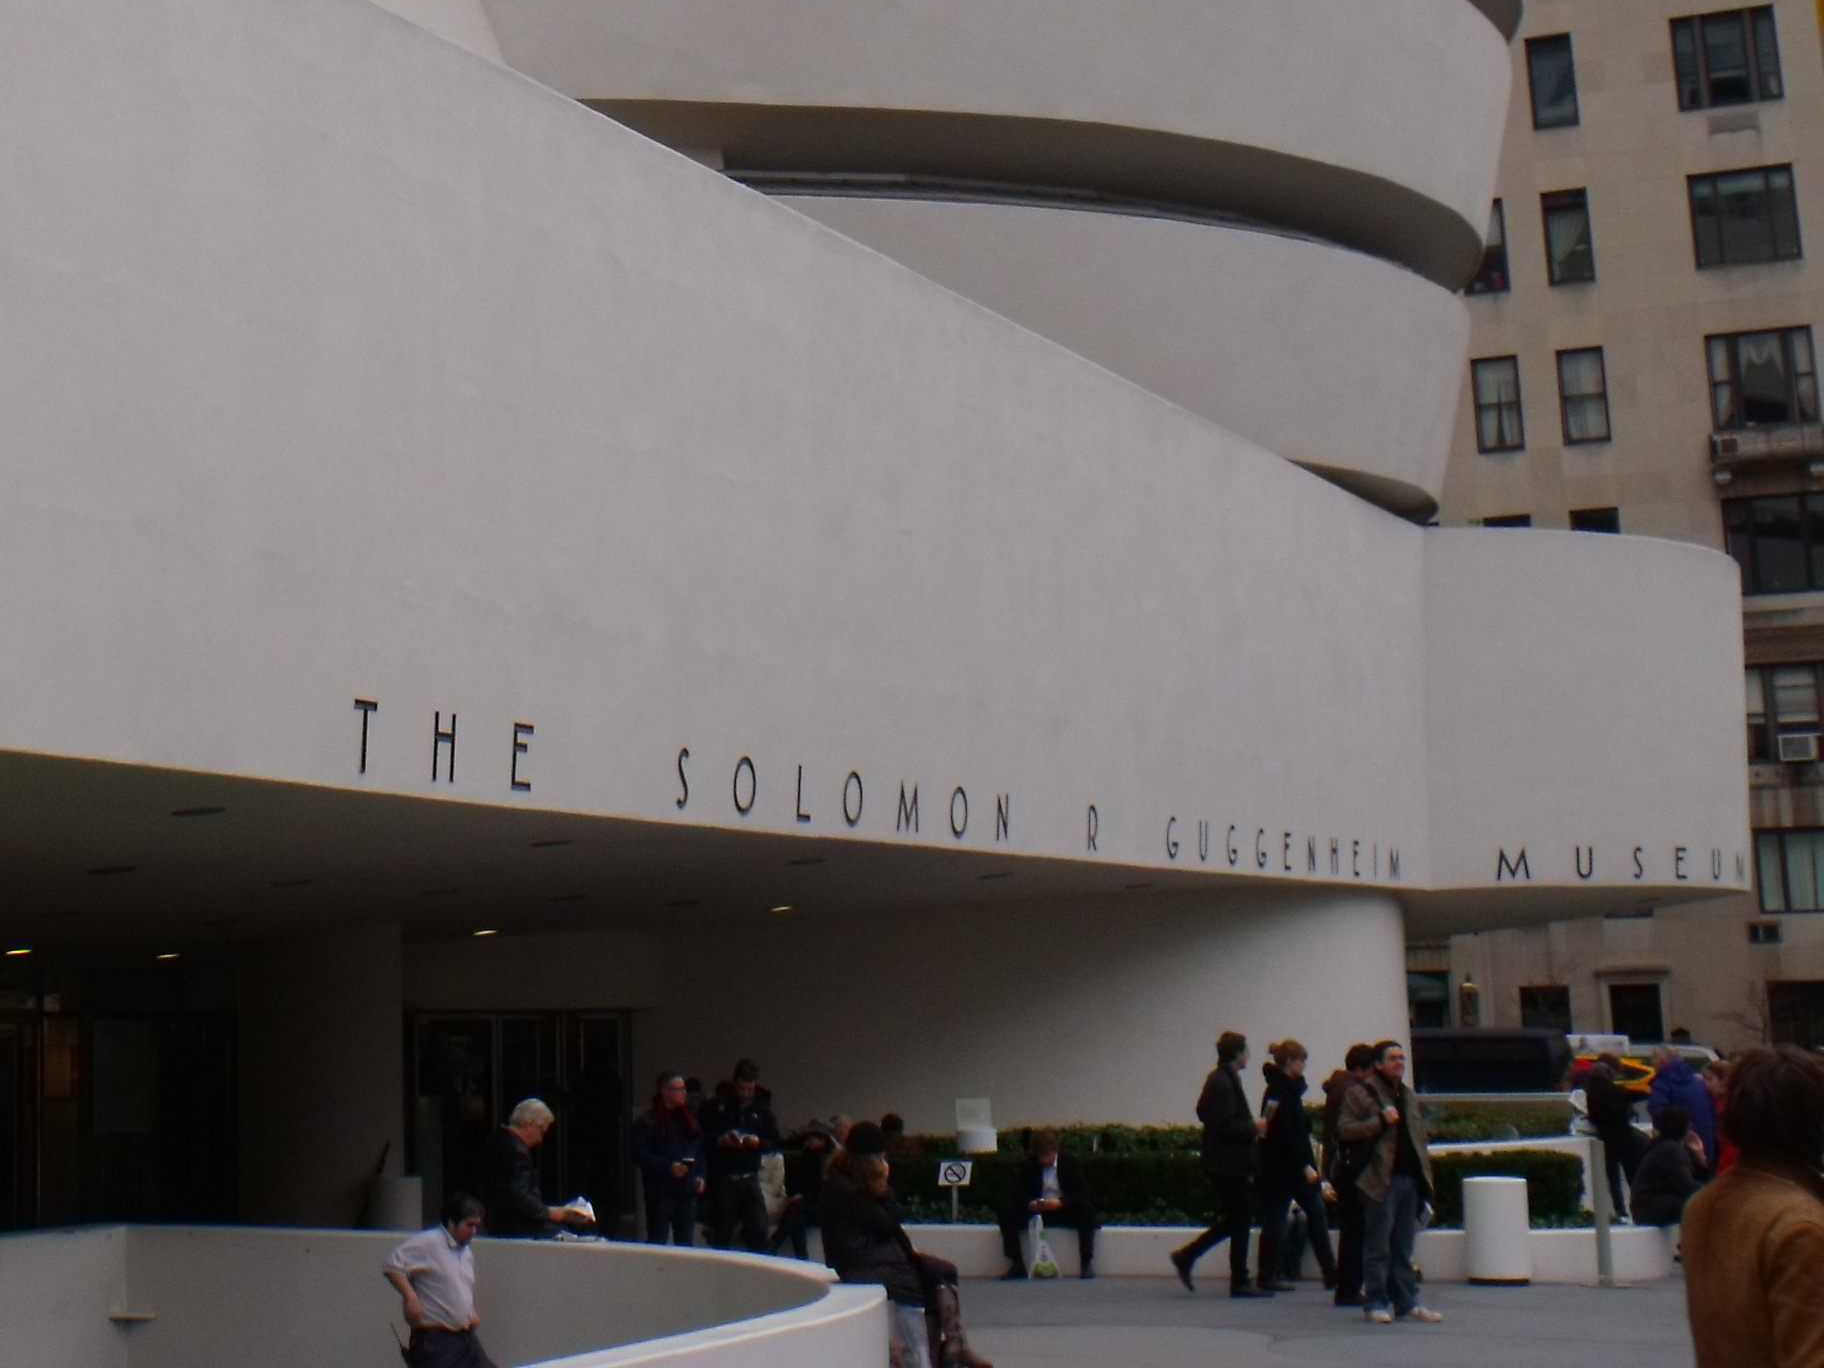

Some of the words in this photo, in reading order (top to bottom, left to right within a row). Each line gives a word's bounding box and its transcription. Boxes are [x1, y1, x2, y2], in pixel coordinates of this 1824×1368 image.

[351, 696, 537, 794] THE
[674, 745, 1012, 843] SOLOMON
[1085, 802, 1101, 853] R
[1164, 814, 1403, 882] GUGGENHEIM
